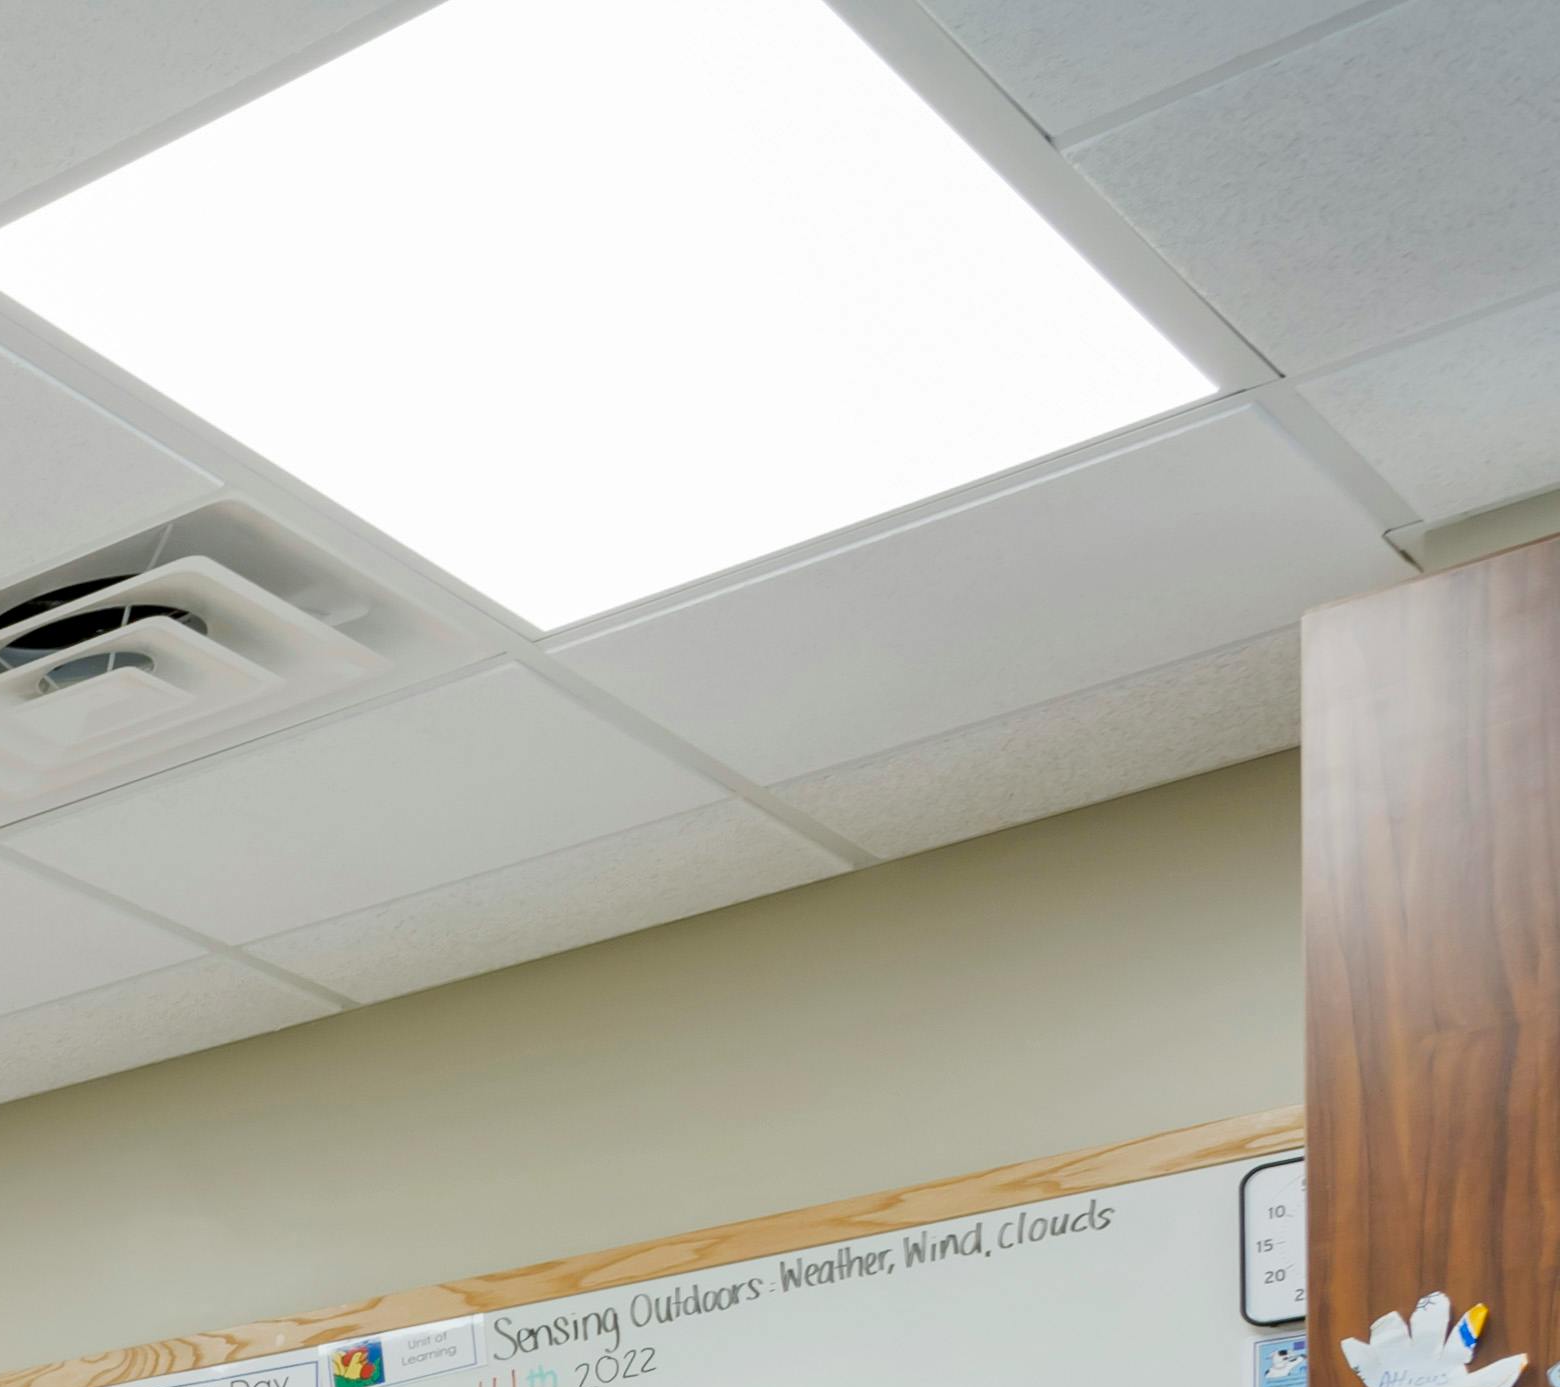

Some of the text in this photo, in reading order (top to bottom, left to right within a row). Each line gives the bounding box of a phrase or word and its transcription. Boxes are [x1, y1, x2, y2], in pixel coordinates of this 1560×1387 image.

[1267, 1204, 1286, 1220] 10
[1256, 1239, 1274, 1253] 15
[1264, 1268, 1286, 1285] 20
[494, 1307, 622, 1361] Sensing
[406, 1335, 432, 1351] Unit
[401, 1344, 458, 1368] Learning
